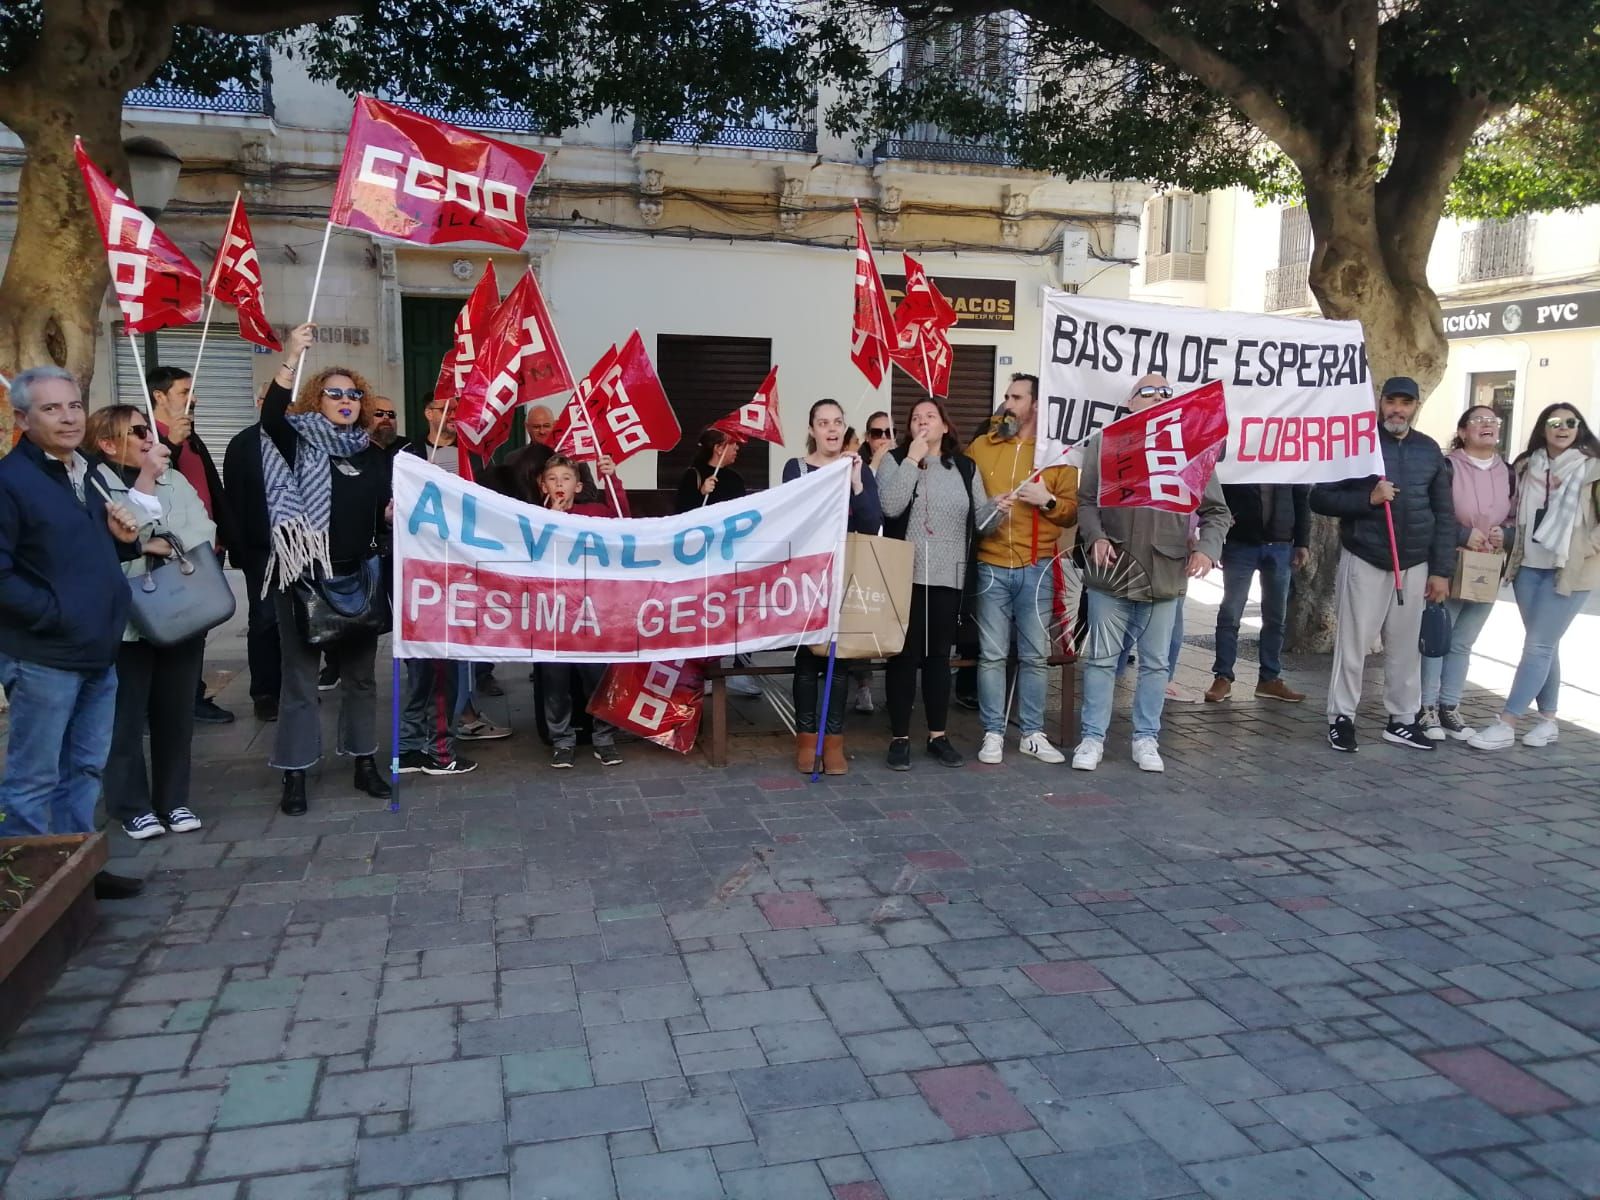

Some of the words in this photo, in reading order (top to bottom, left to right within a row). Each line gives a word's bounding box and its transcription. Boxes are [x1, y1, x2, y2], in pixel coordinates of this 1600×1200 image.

[358, 144, 518, 223] CCOO
[1442, 309, 1491, 333] ICIÓN
[1537, 302, 1579, 324] PVC
[1052, 315, 1169, 376] BASTA
[1177, 335, 1228, 383] DE
[1237, 411, 1376, 462] COBRAR
[408, 481, 762, 569] ALVALOP
[410, 572, 601, 637] PÉSIMA
[637, 564, 829, 638] GESTIÓN
[844, 584, 888, 604] fties
